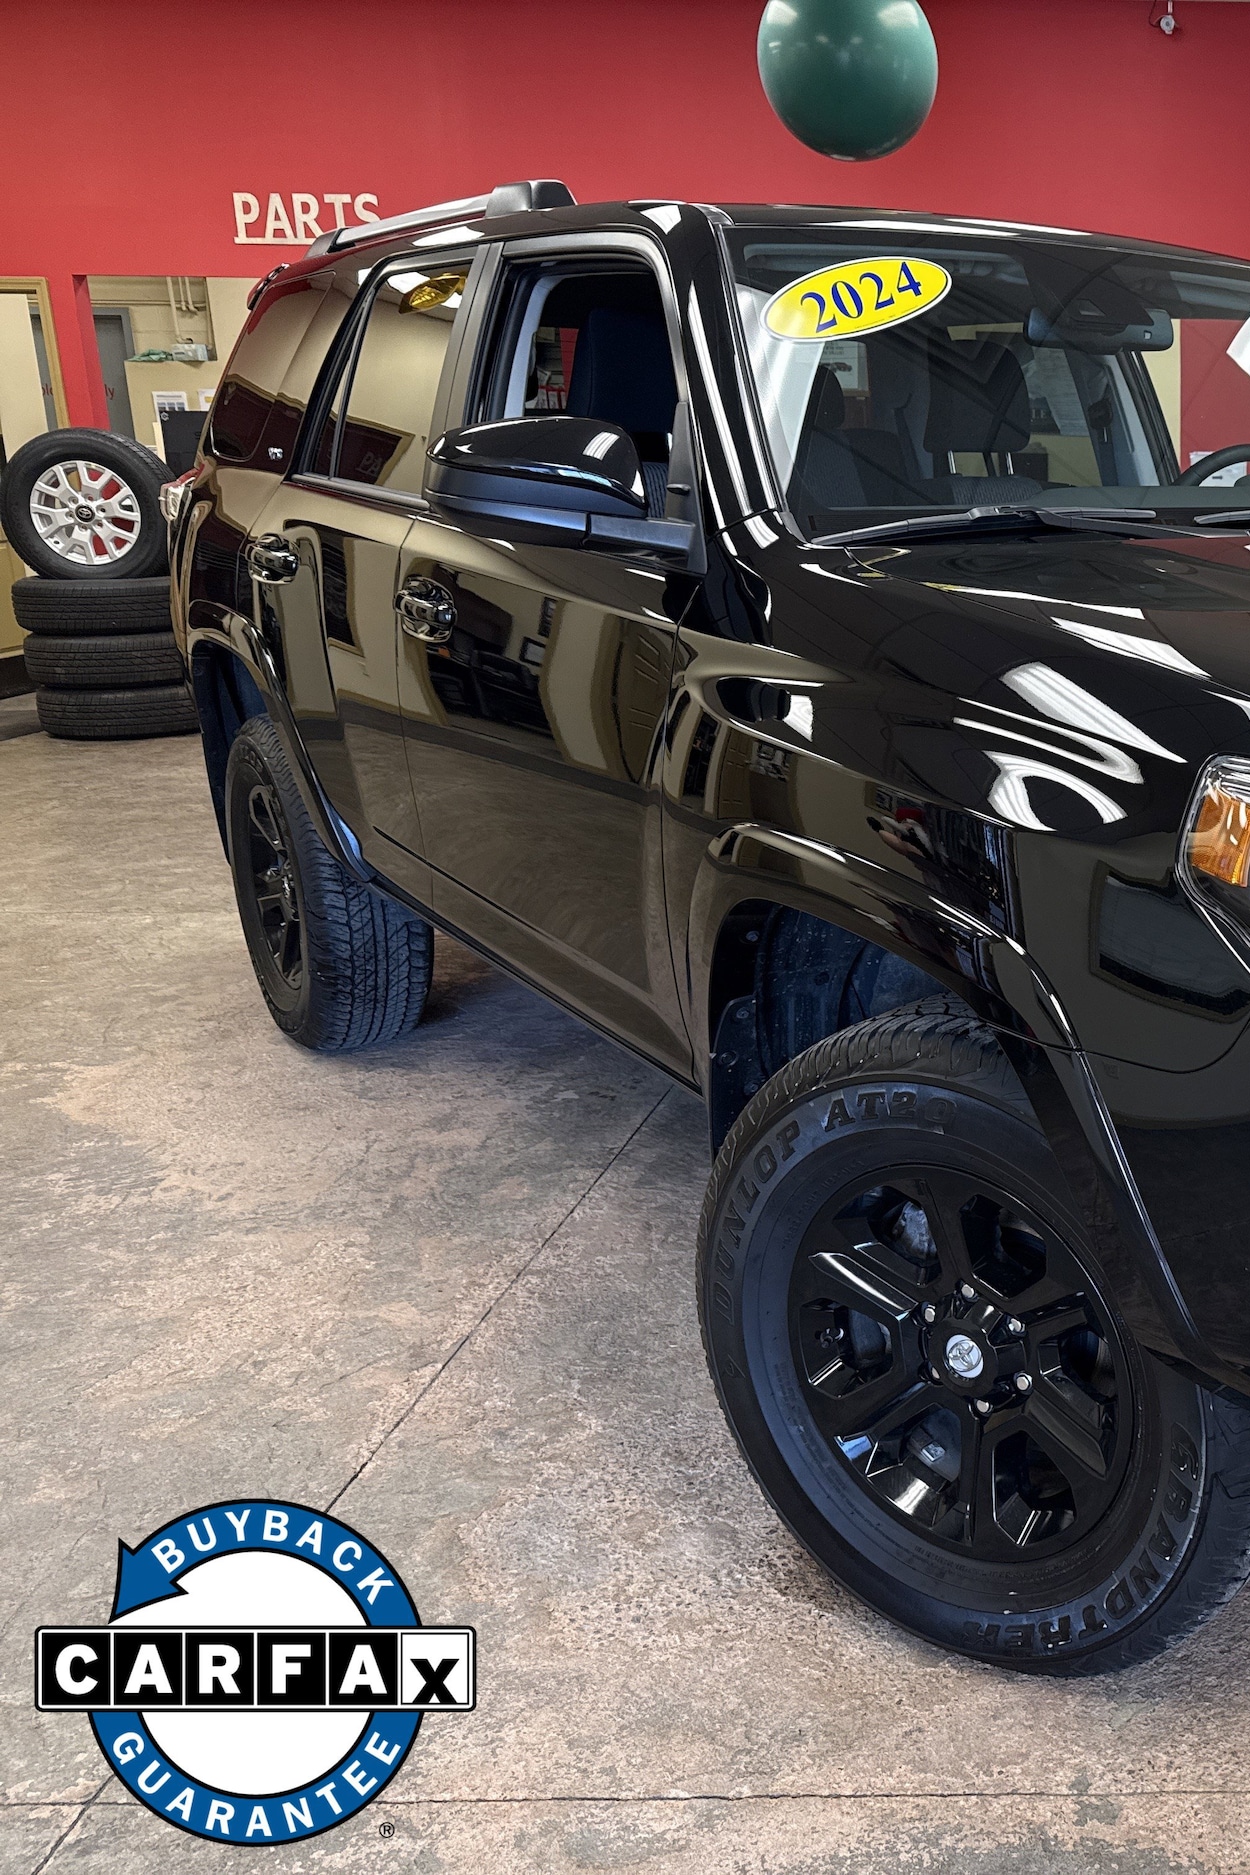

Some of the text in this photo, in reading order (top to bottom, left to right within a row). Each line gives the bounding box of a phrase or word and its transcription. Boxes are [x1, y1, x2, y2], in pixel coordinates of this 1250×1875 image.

[232, 192, 382, 242] PARTS
[800, 261, 922, 333] 2024
[713, 1120, 801, 1326] DUNLOP
[962, 1421, 1201, 1649] GRANDTREK
